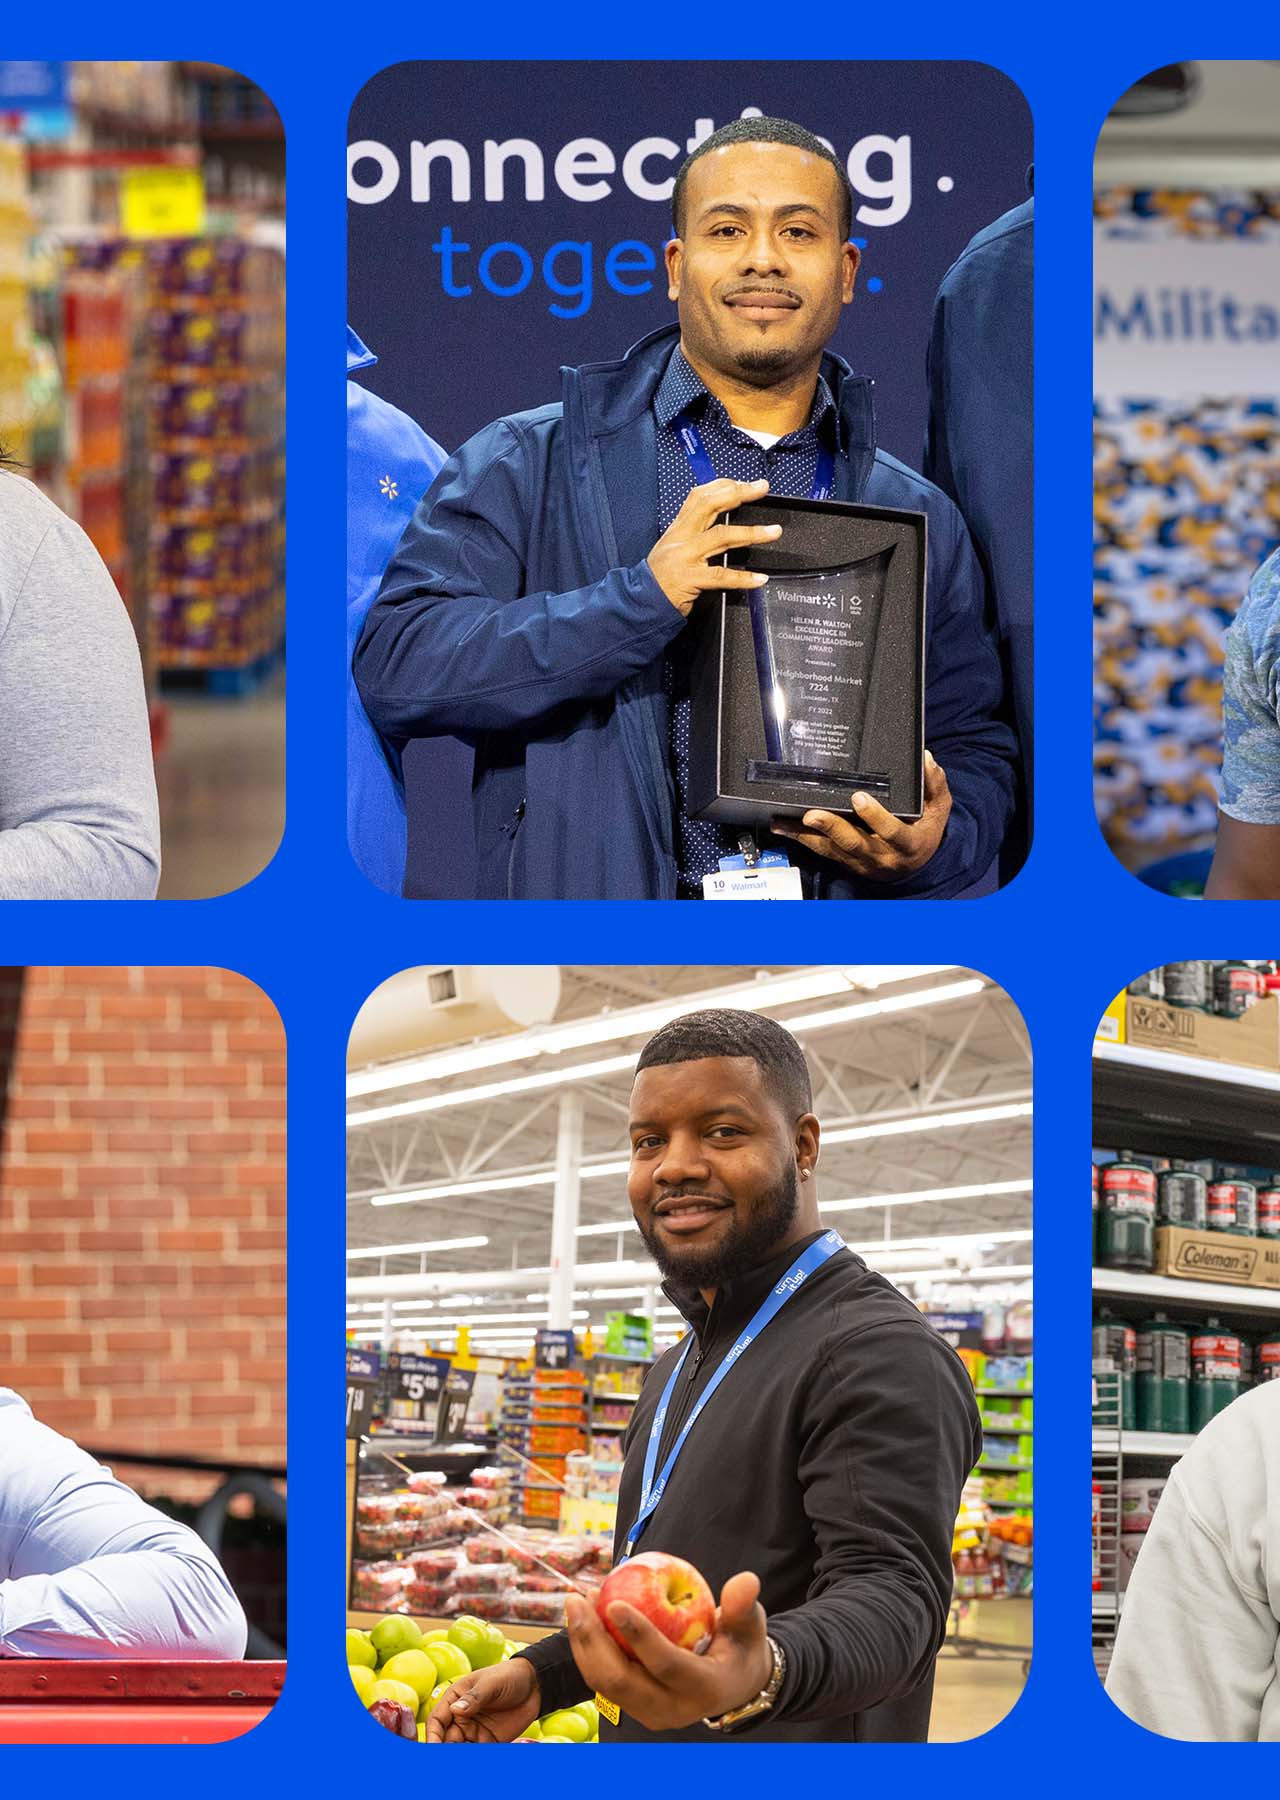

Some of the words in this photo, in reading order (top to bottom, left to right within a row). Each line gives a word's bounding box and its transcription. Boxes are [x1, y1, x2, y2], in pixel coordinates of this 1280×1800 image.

[777, 591, 821, 605] Walmart
[791, 617, 814, 625] HELEN
[823, 619, 852, 629] WALTON
[795, 625, 838, 637] EXCELLENCE
[776, 632, 821, 644] COMMUNITY
[808, 644, 833, 653] AWARD
[776, 669, 833, 683] Neighborhood
[834, 675, 863, 686] Market
[809, 682, 829, 692] 7224
[713, 881, 725, 889] 10
[730, 880, 768, 891] Walmart
[1183, 1245, 1240, 1269] Coleman
[775, 1276, 793, 1294] turn
